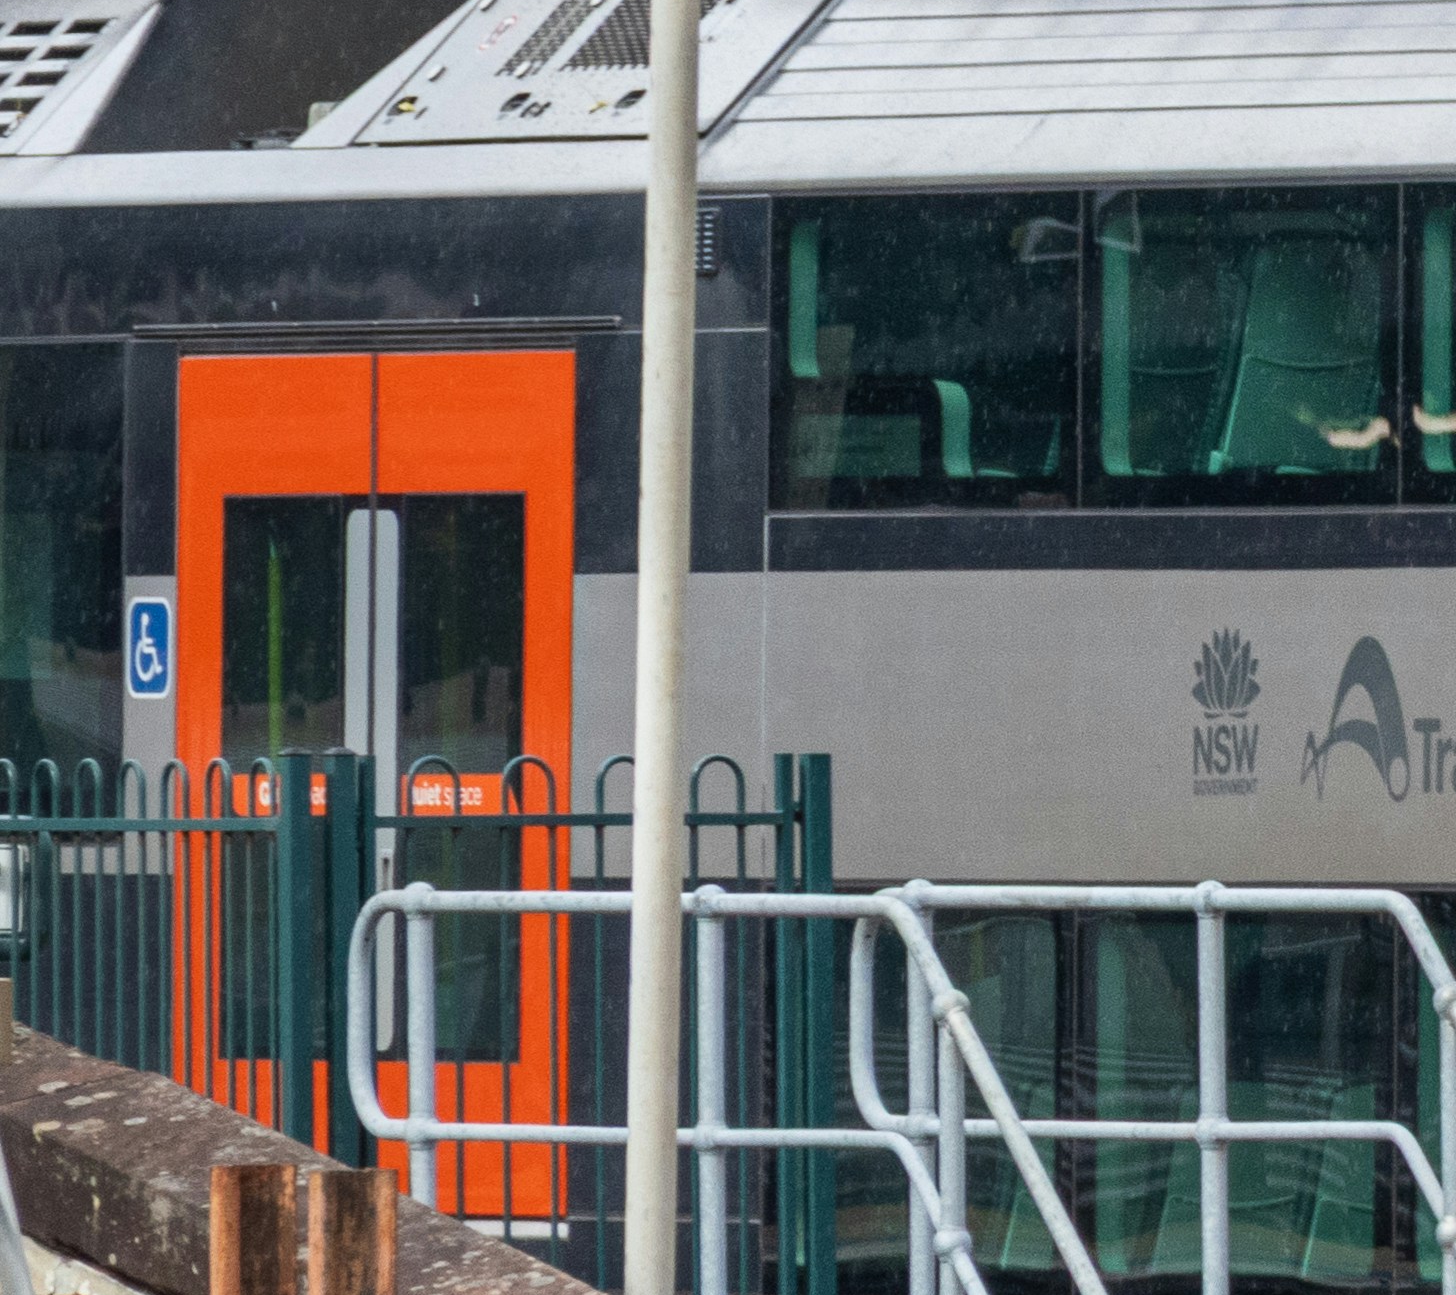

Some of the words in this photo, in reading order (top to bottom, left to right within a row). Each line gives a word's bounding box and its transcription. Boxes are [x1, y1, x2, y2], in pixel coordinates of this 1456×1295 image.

[1192, 723, 1259, 775] NSW
[411, 781, 441, 807] uiet
[443, 786, 483, 811] sace
